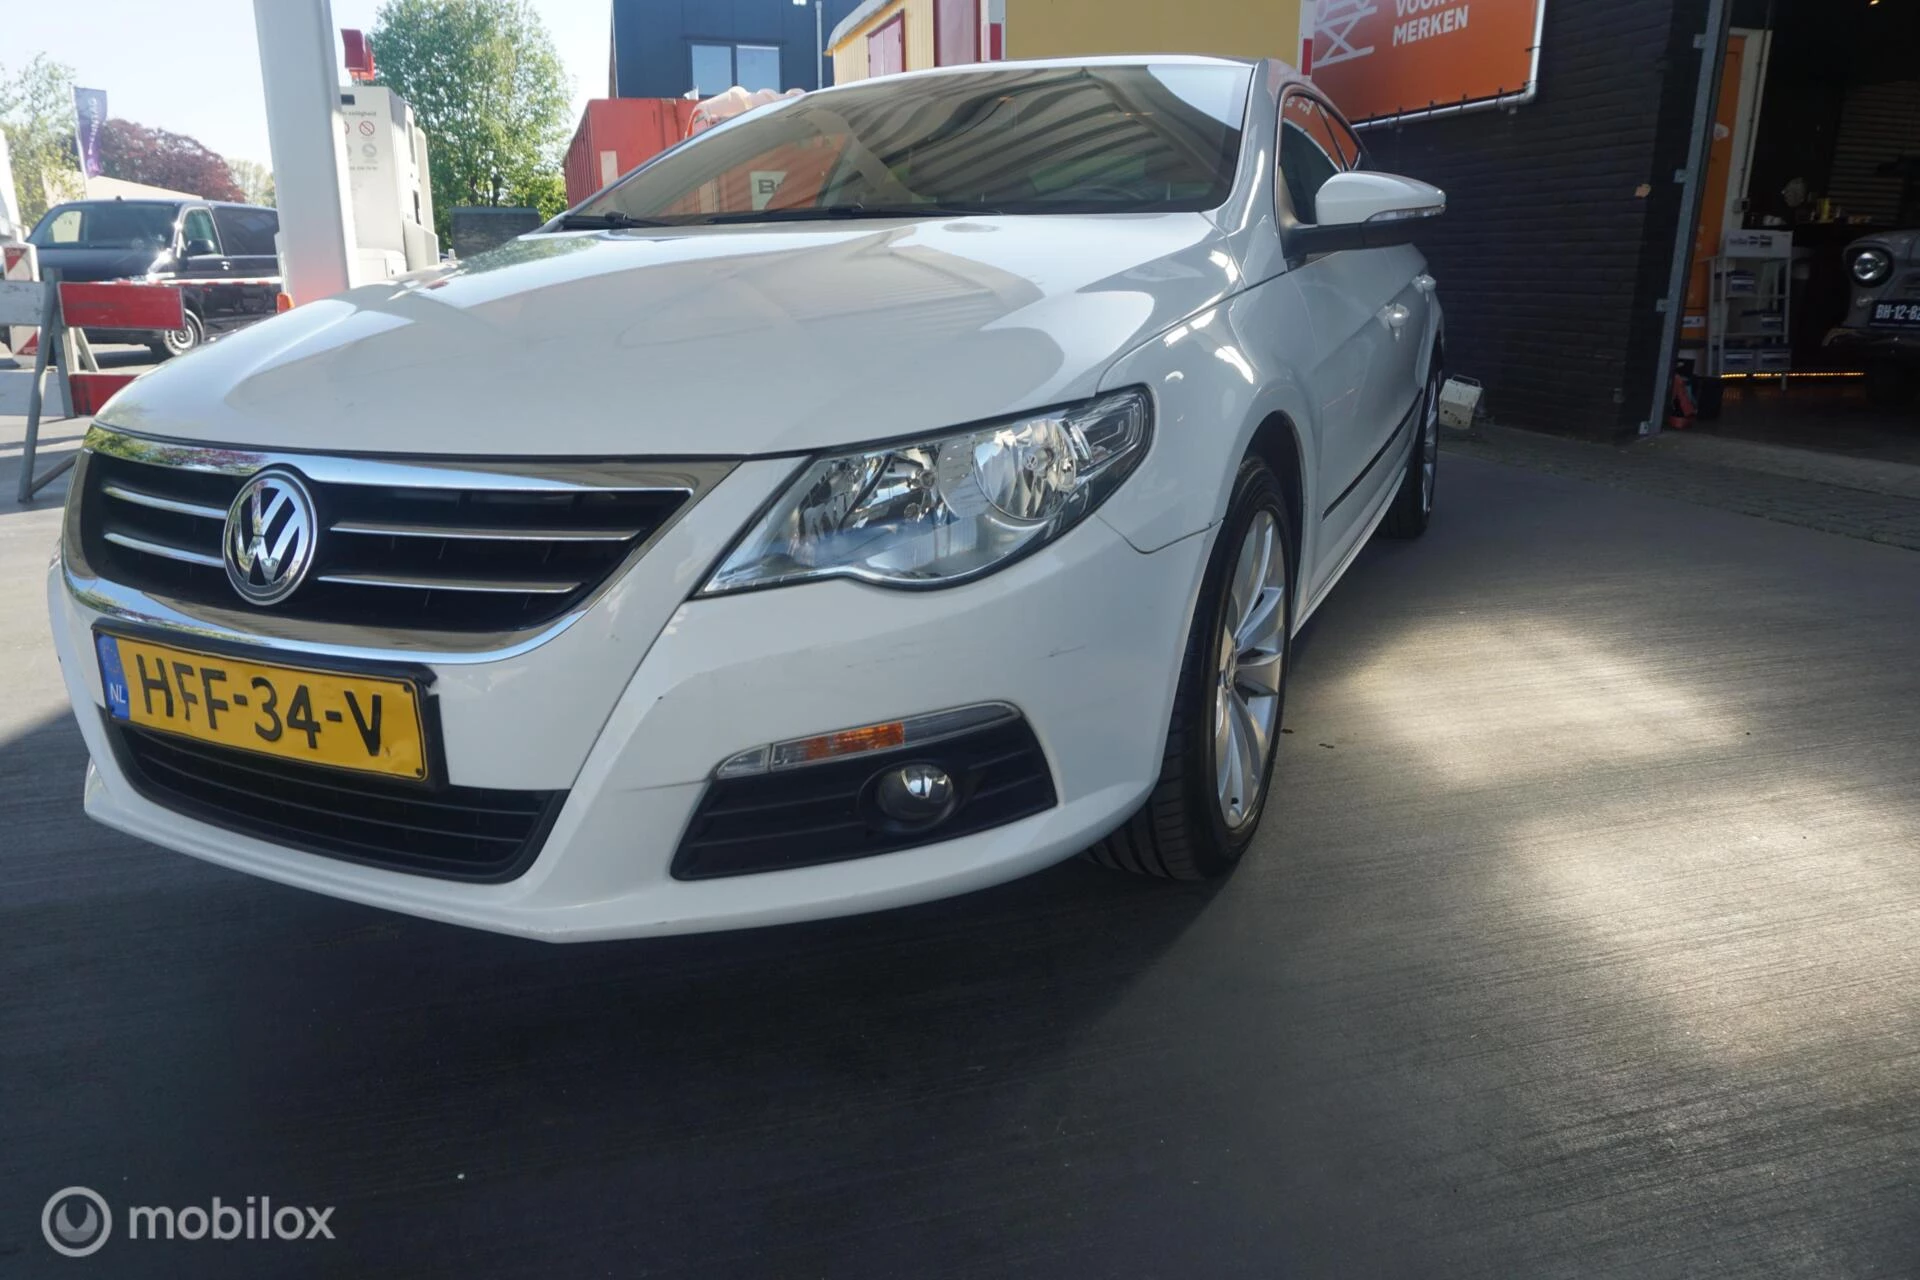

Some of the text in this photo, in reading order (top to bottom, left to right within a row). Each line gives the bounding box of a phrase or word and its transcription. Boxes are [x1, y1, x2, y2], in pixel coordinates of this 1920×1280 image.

[1393, 5, 1469, 47] MERKEN
[110, 683, 126, 704] NL
[136, 654, 382, 757] HFF-34-V
